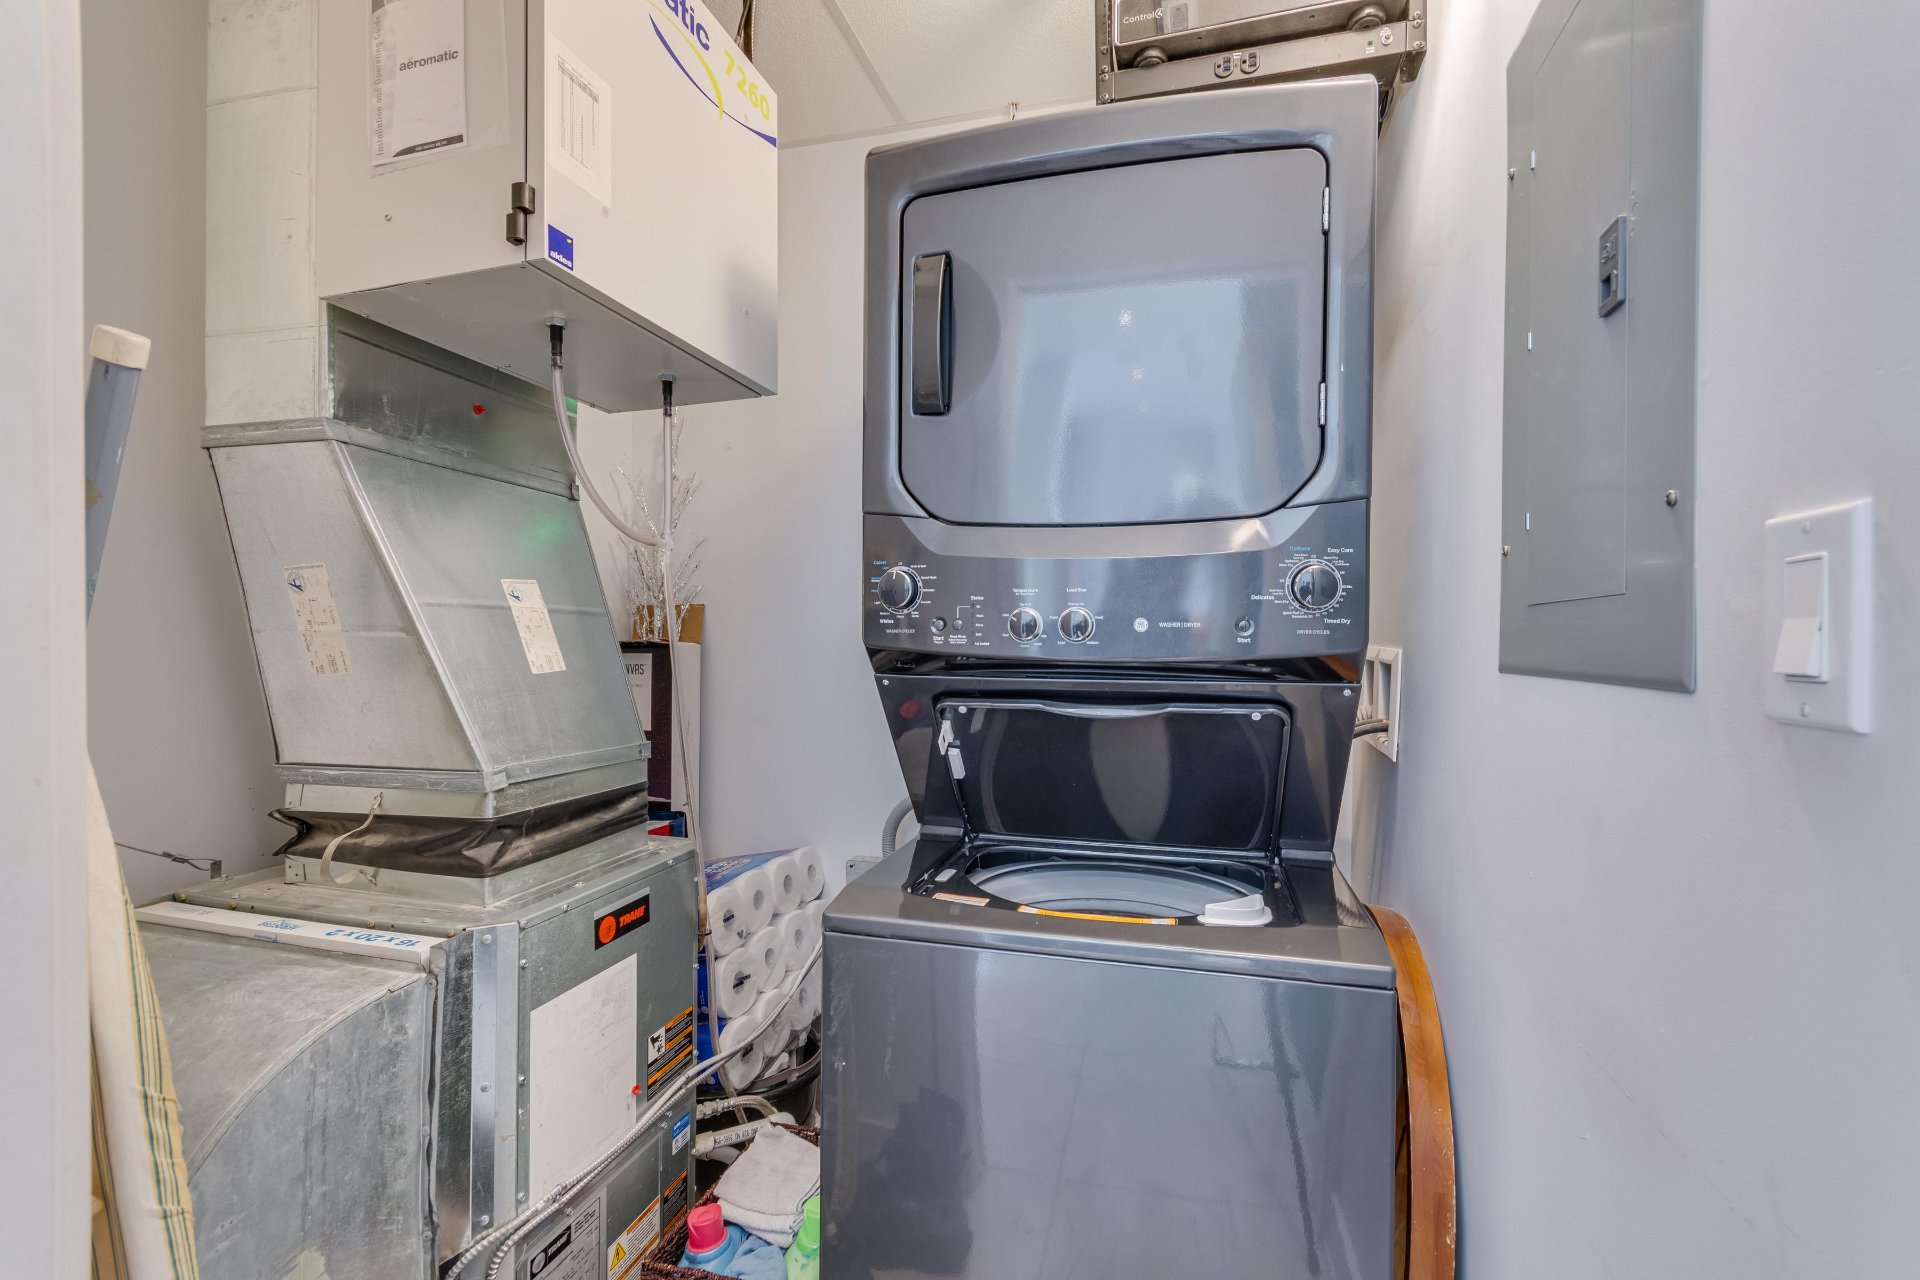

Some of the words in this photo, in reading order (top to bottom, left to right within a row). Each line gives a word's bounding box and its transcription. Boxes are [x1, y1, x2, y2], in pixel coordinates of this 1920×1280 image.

[723, 48, 770, 121] 7260
[375, 87, 383, 104] and
[550, 250, 573, 268] aldes
[619, 905, 646, 927] TRANE
[354, 933, 385, 942] 20
[396, 939, 421, 947] 16
